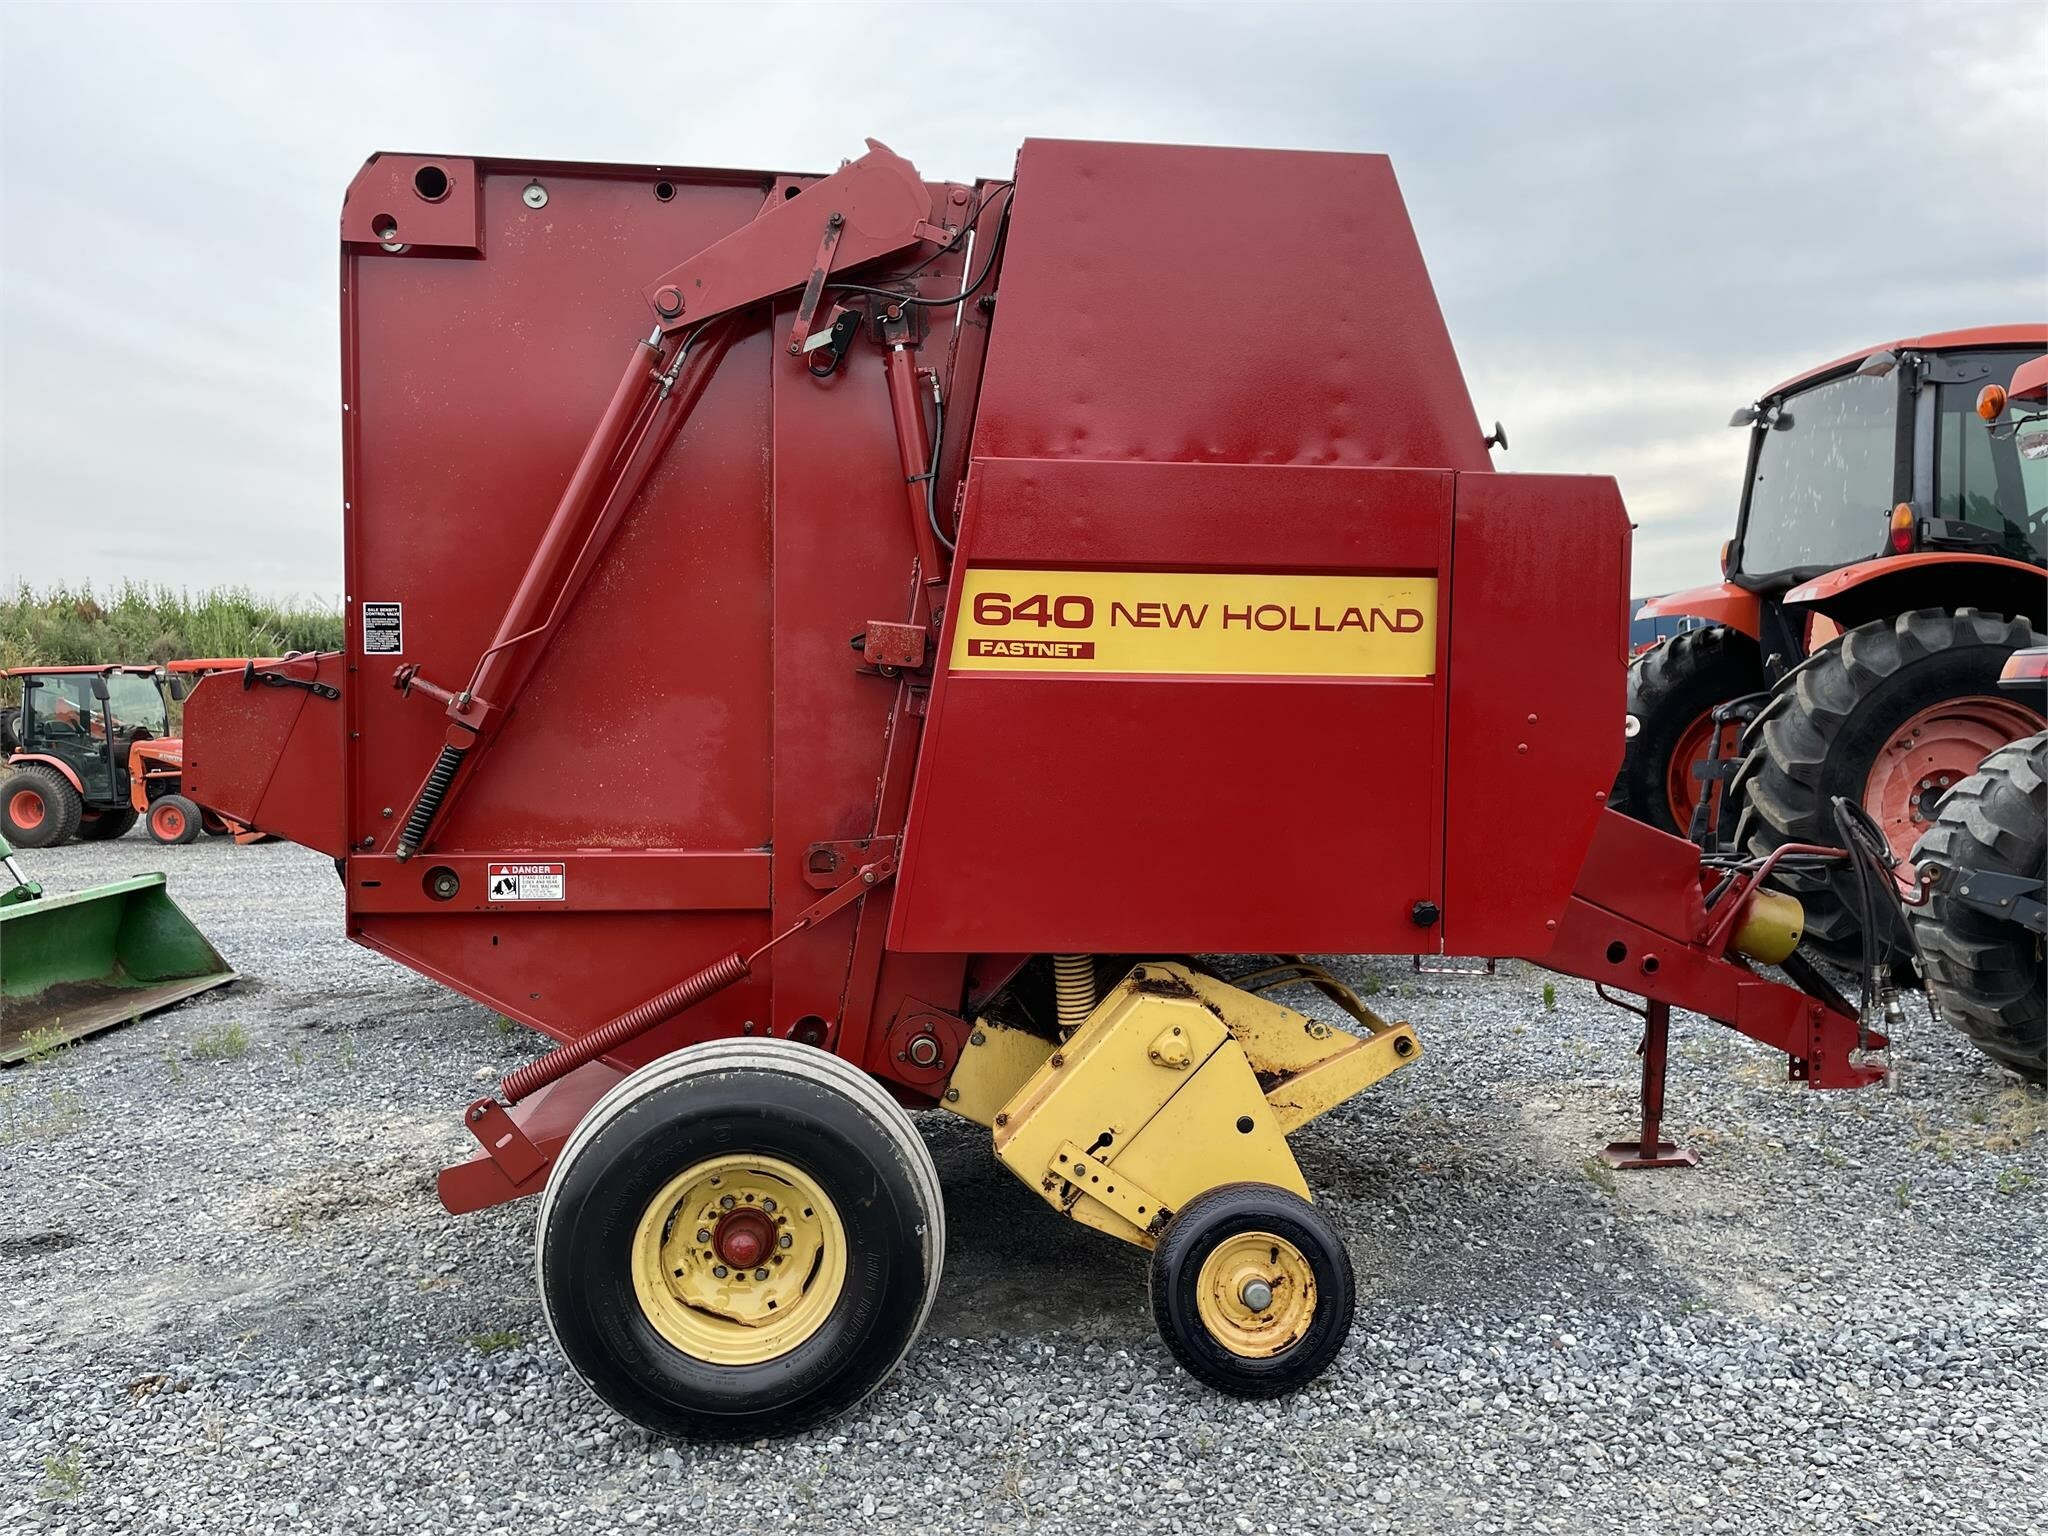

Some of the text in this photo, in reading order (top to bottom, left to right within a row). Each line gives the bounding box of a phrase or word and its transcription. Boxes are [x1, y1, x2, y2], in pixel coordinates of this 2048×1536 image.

[973, 592, 1426, 634] 640 NEW HOLLAND
[978, 641, 1083, 659] FASTNET
